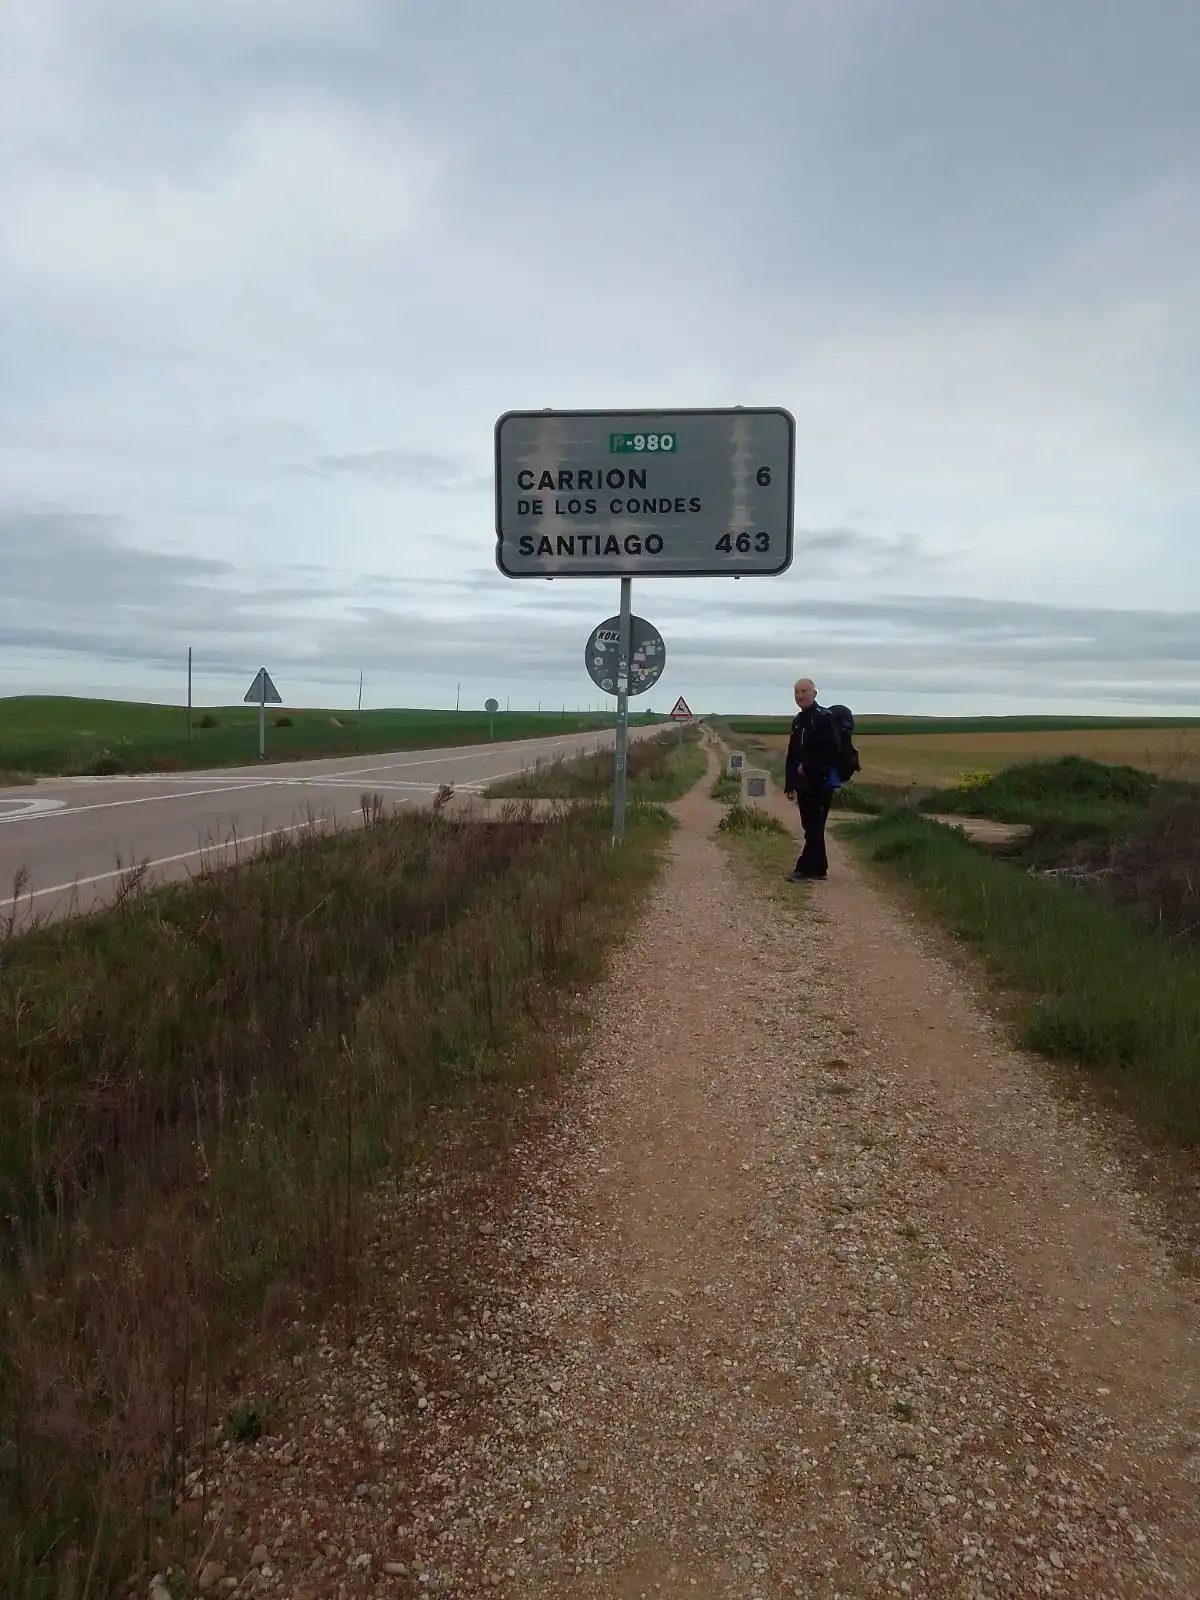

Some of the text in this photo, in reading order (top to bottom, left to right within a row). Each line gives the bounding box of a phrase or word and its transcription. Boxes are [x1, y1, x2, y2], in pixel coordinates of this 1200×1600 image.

[517, 466, 772, 491] CARRION 6
[517, 497, 702, 515] DE LOS CONDES
[518, 532, 771, 556] SANTIAGO 463
